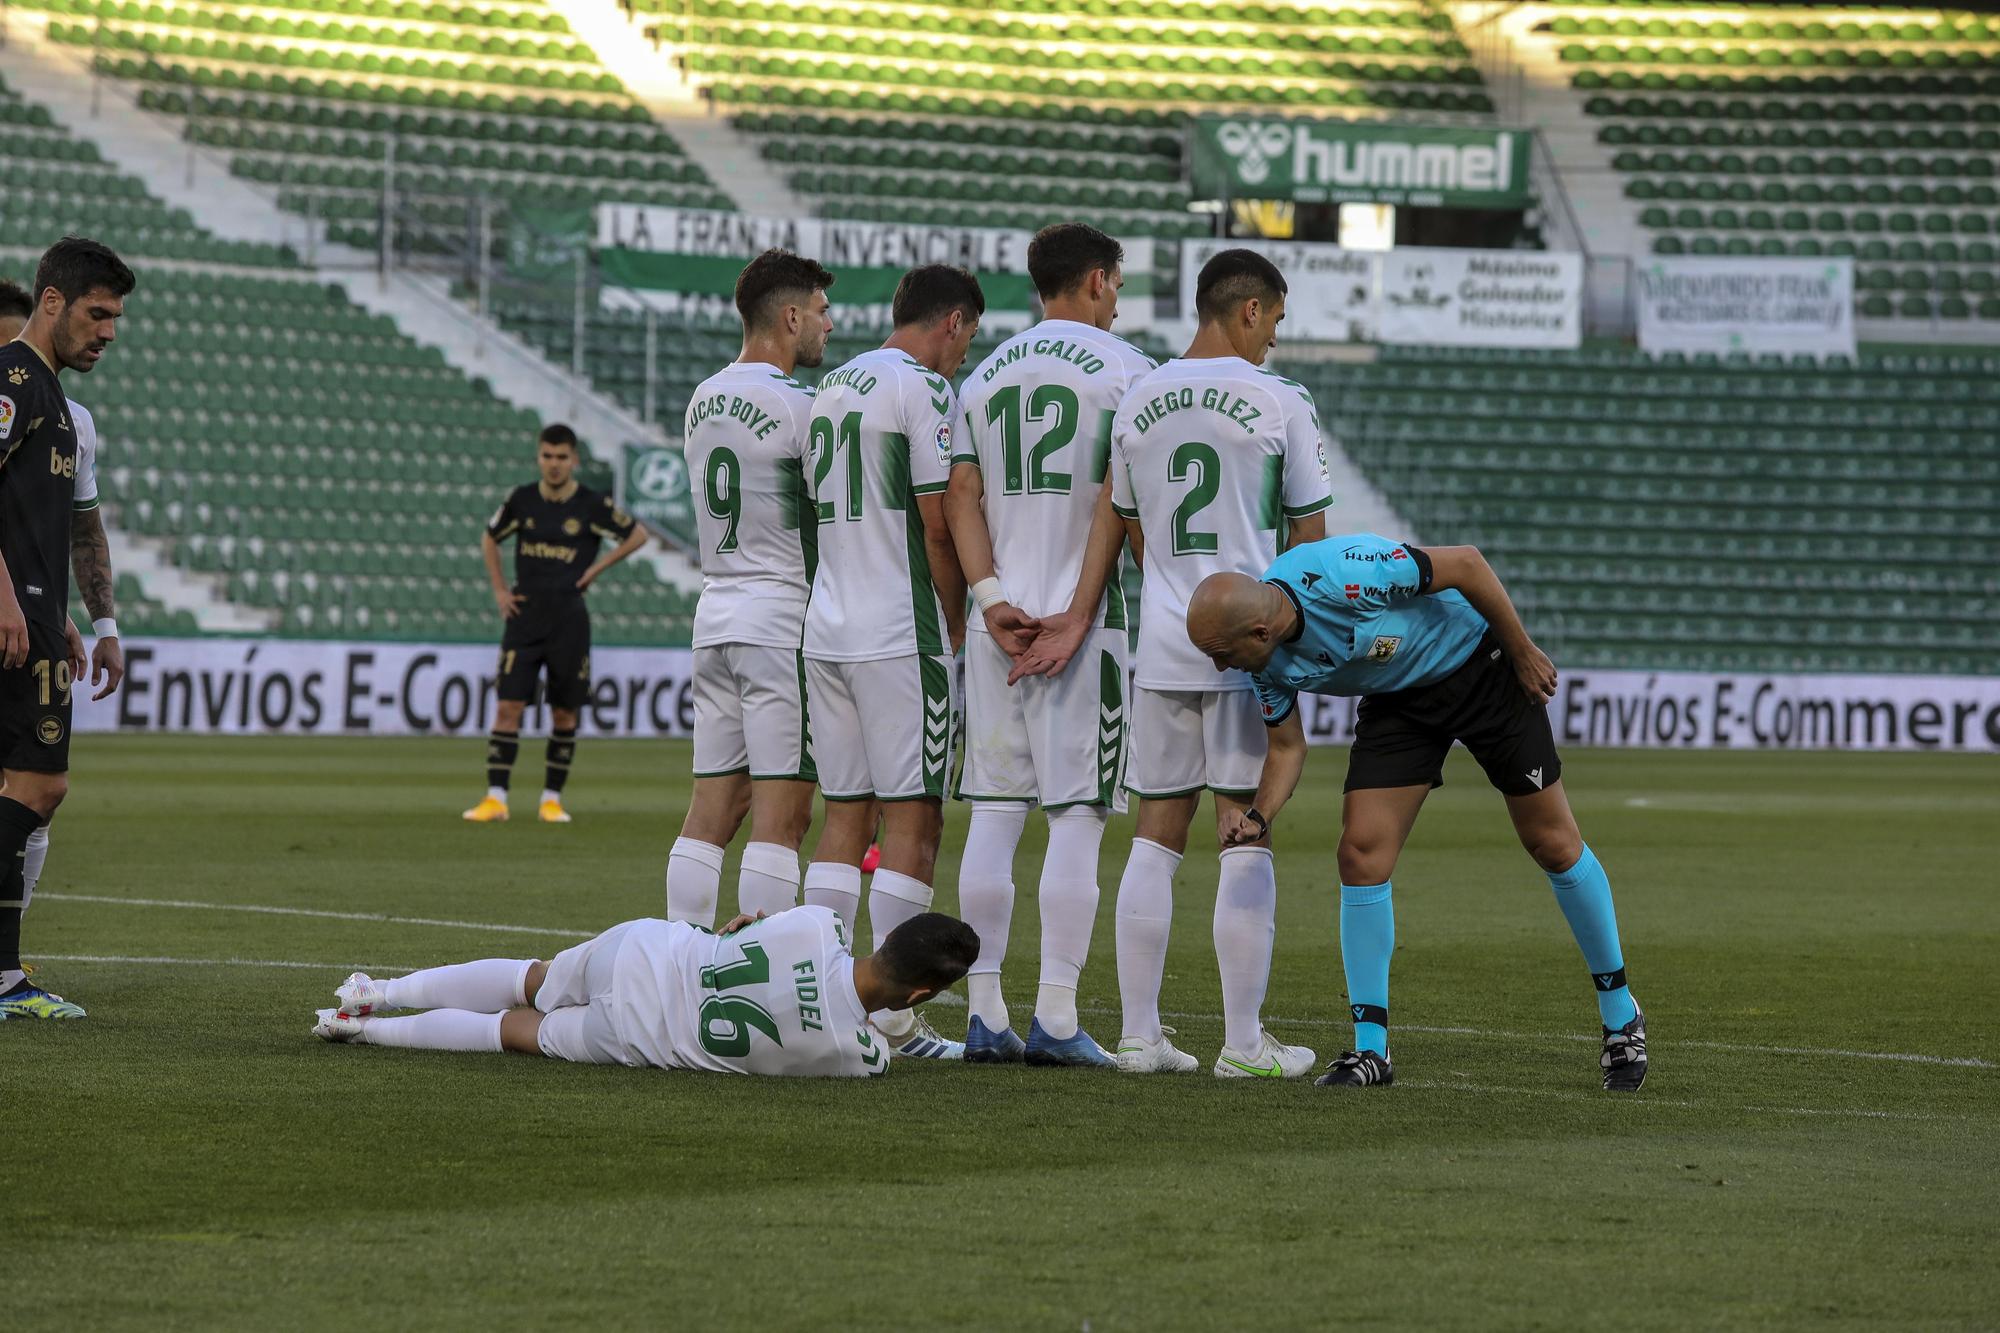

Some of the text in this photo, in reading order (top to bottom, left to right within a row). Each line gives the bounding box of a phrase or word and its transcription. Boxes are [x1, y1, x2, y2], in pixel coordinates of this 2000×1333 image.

[1293, 125, 1514, 191] hummel
[611, 206, 650, 245] LA
[816, 367, 877, 397] ARRILLO
[983, 342, 1028, 383] DANI
[688, 394, 781, 441] LUCAS BOYÉ
[985, 384, 1079, 496] 12
[1132, 387, 1262, 435] DIEGO GLEZ.
[704, 446, 742, 554] 9
[810, 411, 864, 524] 21
[1167, 441, 1222, 557] 2
[520, 541, 577, 565] betway
[32, 659, 71, 706] 19
[119, 646, 323, 728] Envíos
[1563, 674, 1701, 742] Envíos
[699, 940, 783, 1058] 16
[792, 959, 823, 1032] FIDEL
